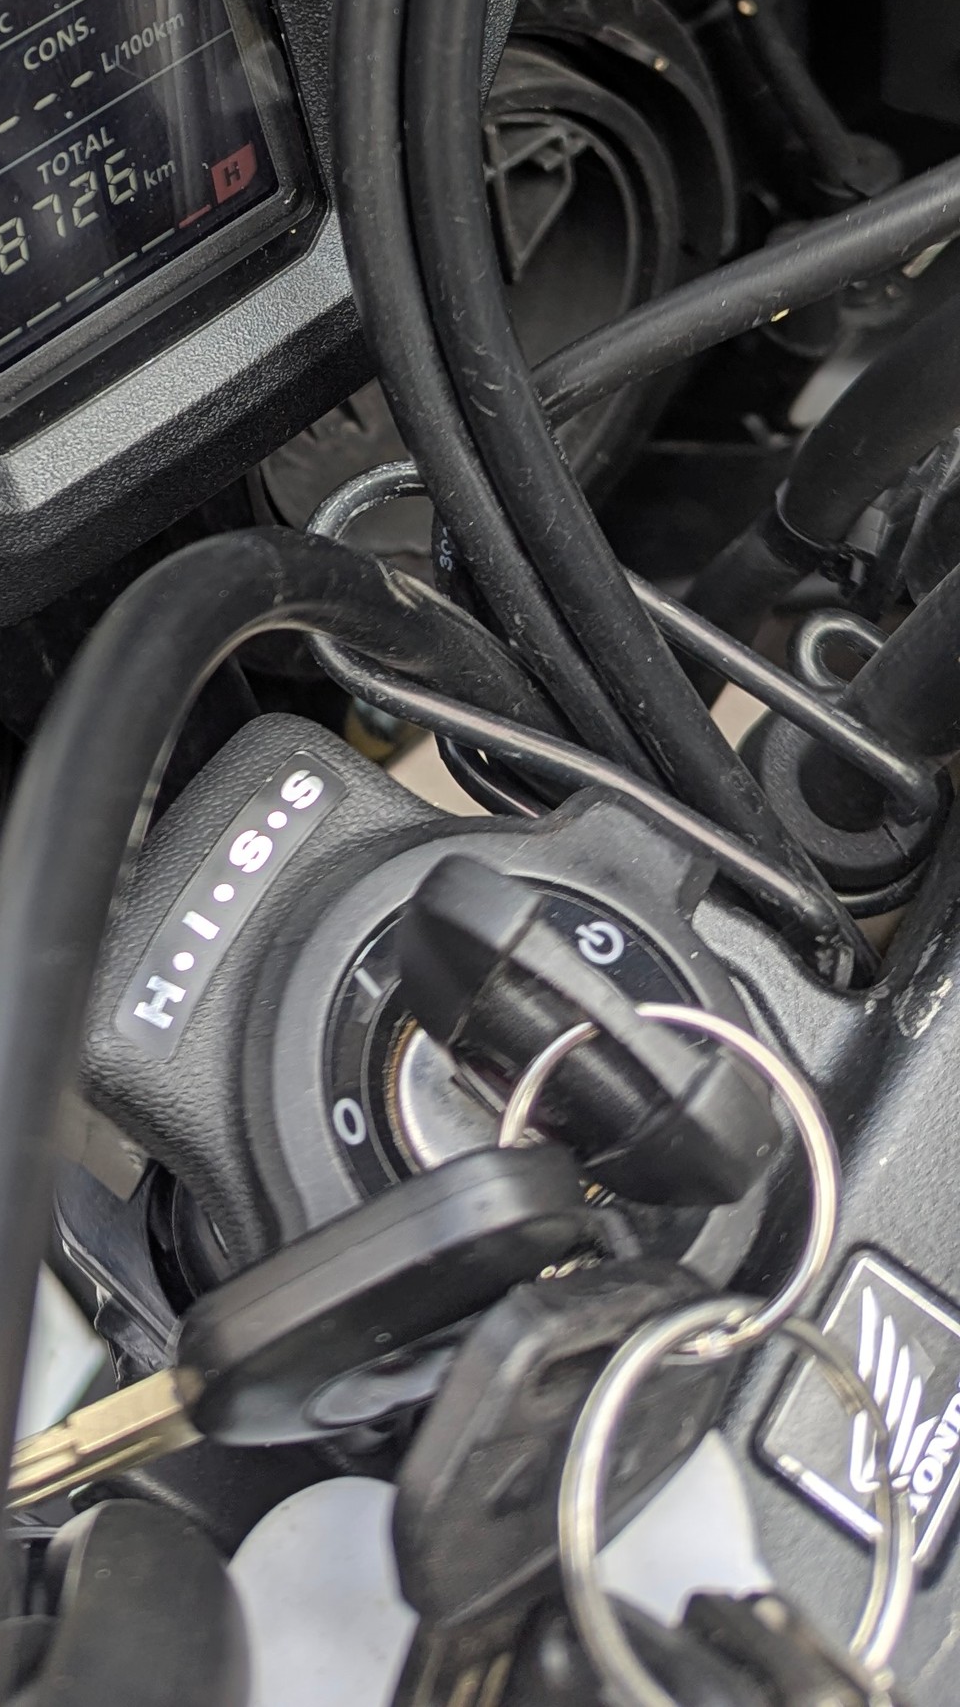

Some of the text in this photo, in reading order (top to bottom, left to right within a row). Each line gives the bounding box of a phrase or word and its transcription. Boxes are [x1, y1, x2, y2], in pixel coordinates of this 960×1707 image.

[23, 16, 96, 71] CONS.
[100, 12, 185, 74] L/100km
[37, 126, 115, 185] TOTAL
[143, 159, 178, 190] km
